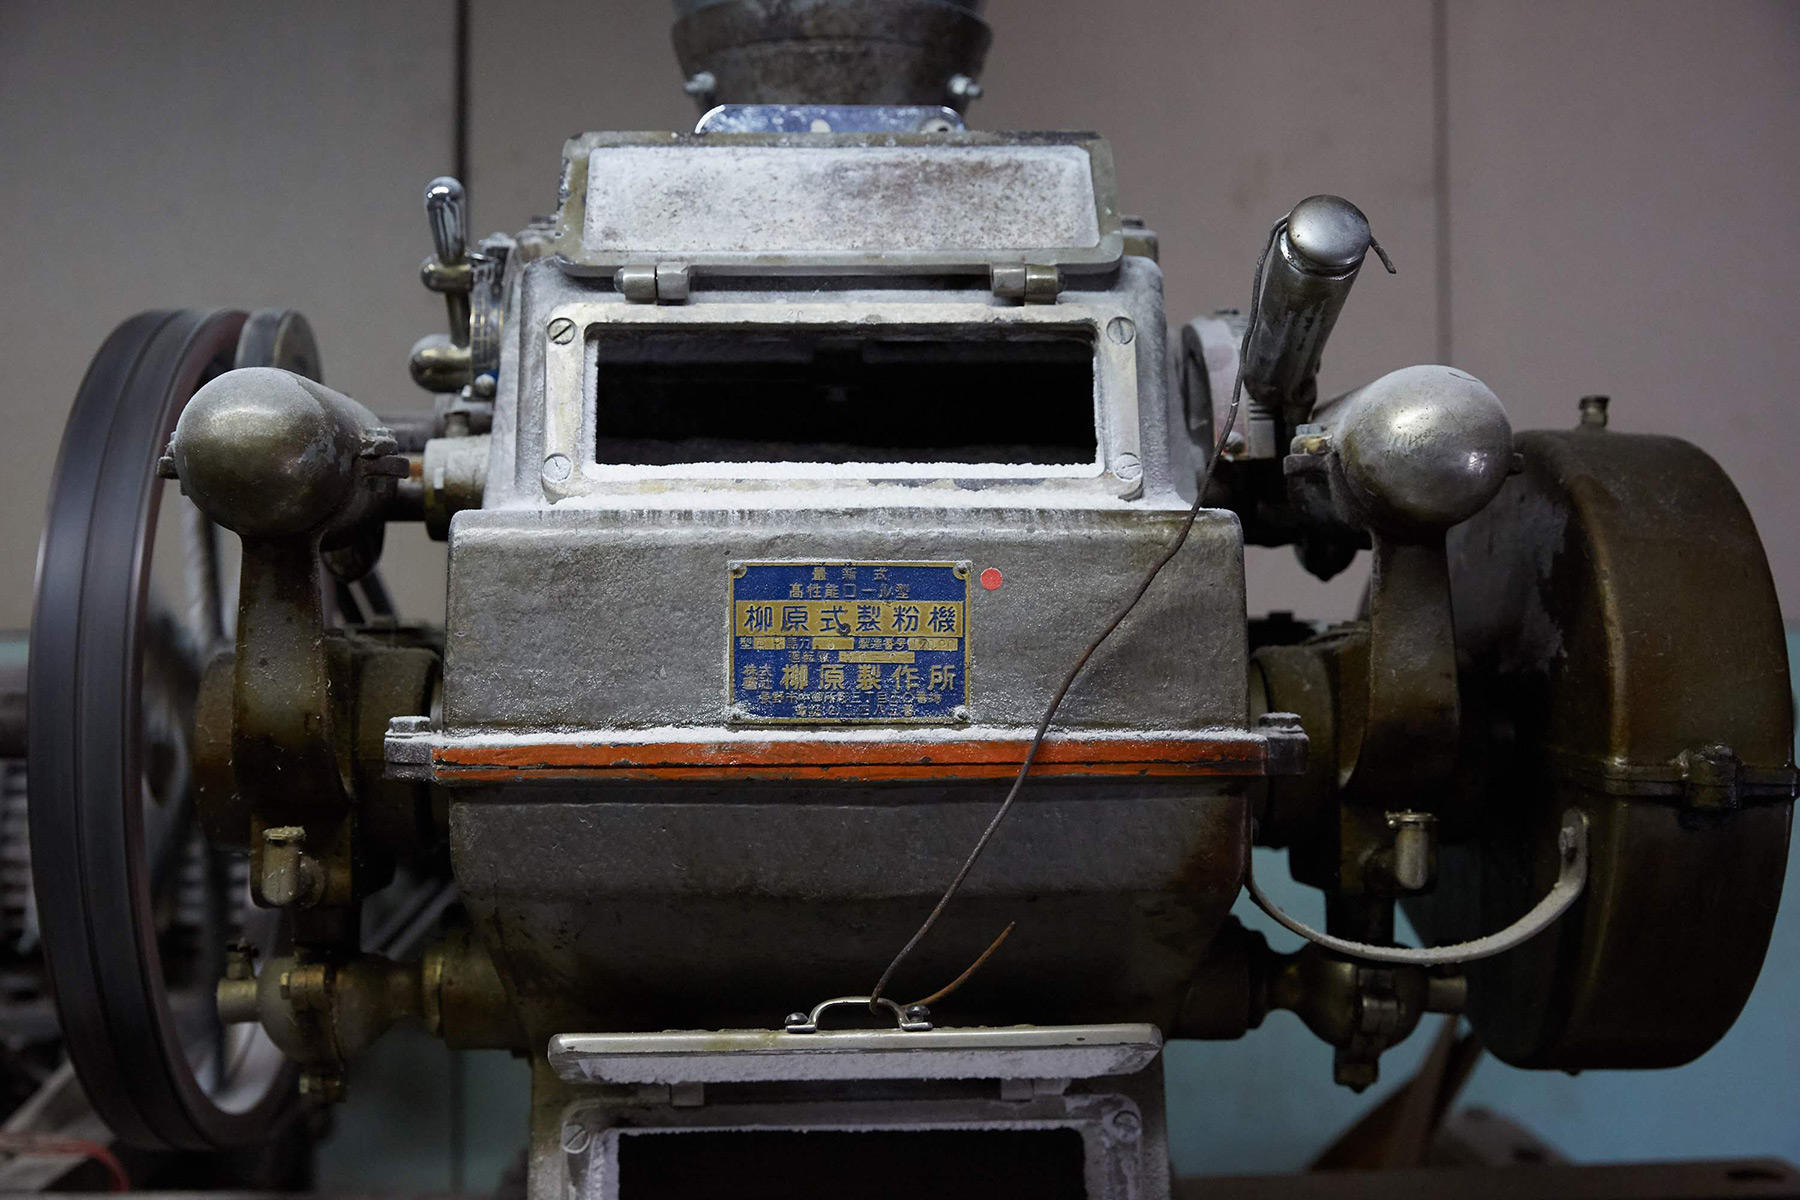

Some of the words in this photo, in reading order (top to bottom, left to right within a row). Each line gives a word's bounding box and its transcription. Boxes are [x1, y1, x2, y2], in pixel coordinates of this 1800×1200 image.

[811, 566, 888, 581] 最新式
[743, 604, 957, 633] 柳原式製粉機
[781, 663, 957, 691] 柳原製作所
